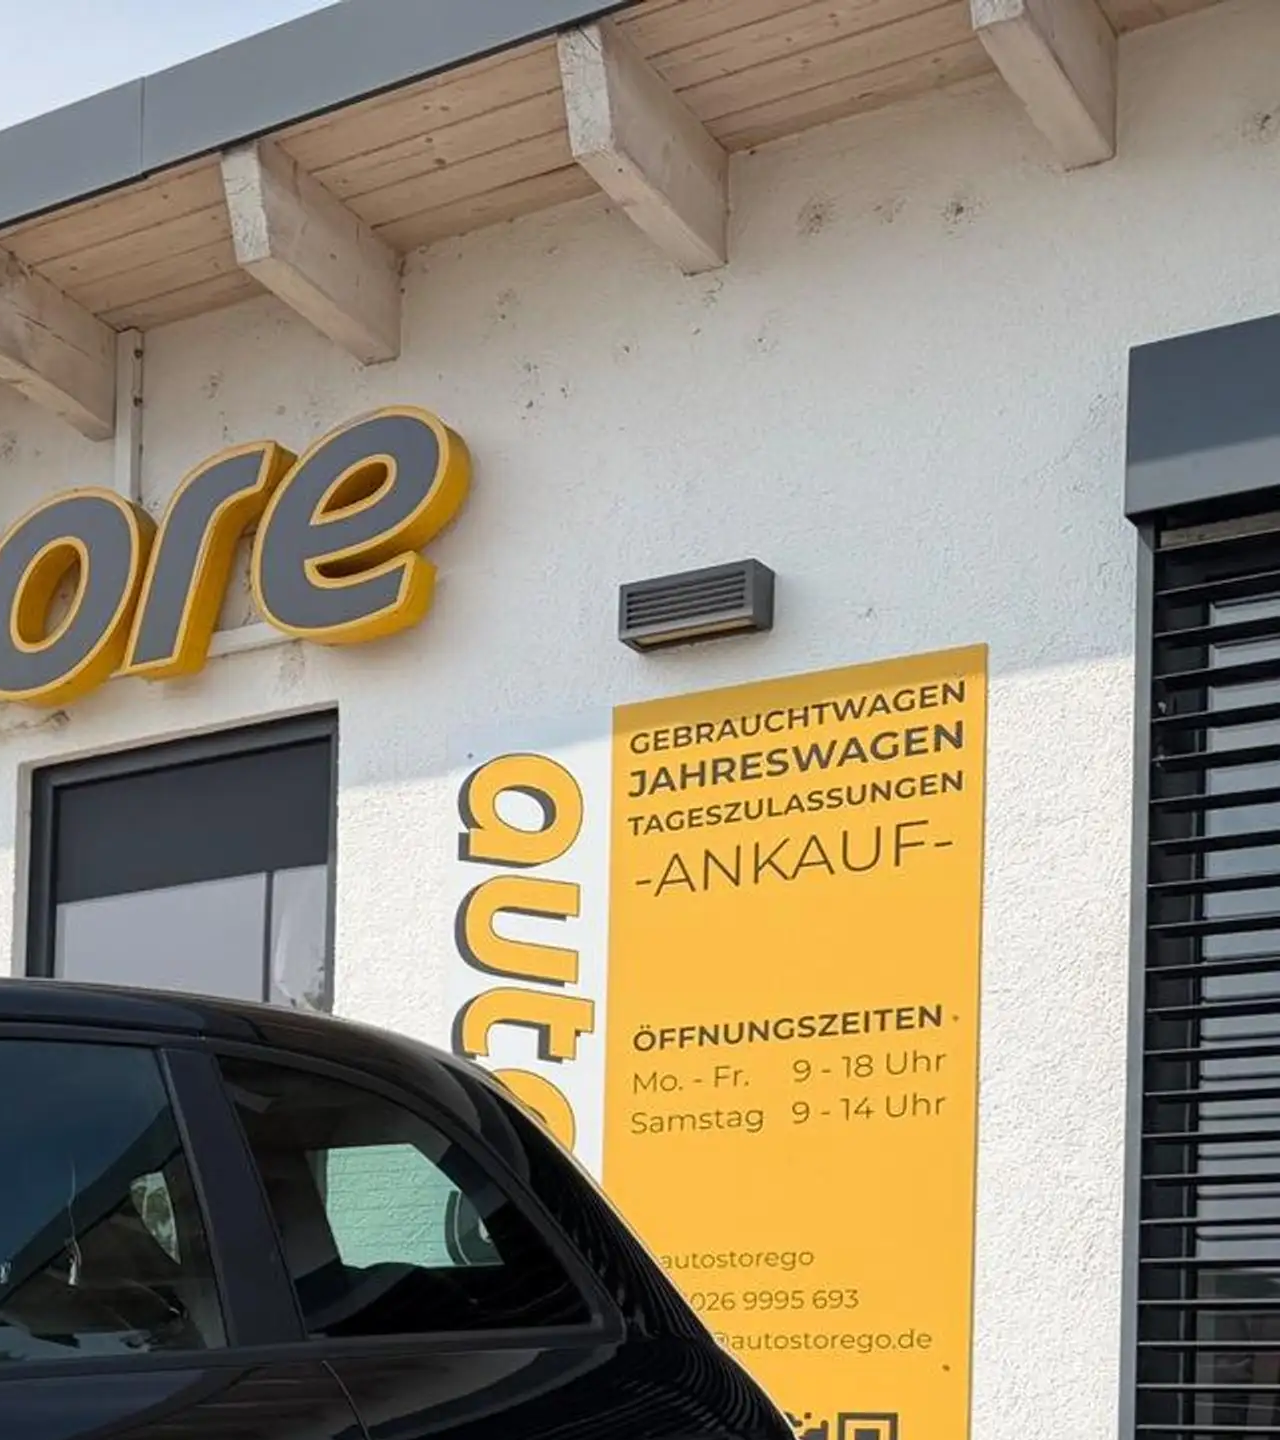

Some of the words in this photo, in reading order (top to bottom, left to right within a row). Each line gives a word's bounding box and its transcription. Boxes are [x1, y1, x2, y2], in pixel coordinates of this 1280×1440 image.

[630, 680, 966, 755] GEBRAUCHTWAGEN
[628, 720, 964, 798] JAHRESWAGEN
[628, 770, 964, 836] TAGESZULASSUNGEN
[636, 820, 953, 897] -ANKAUF-
[633, 1004, 942, 1052] ÖFFNUNGSZEITEN
[633, 1072, 684, 1094] Mo.
[714, 1065, 750, 1088] Fr.
[792, 1059, 811, 1083] 9
[841, 1054, 874, 1079] 18
[886, 1050, 947, 1076] Uhr
[631, 1107, 764, 1134] Samstag
[791, 1101, 810, 1124] 9
[841, 1097, 874, 1121] 14
[886, 1093, 947, 1118] Uhr
[659, 1250, 815, 1272] autostorego
[684, 1291, 736, 1312] 026
[742, 1289, 805, 1311] 9995
[812, 1288, 860, 1311] 693
